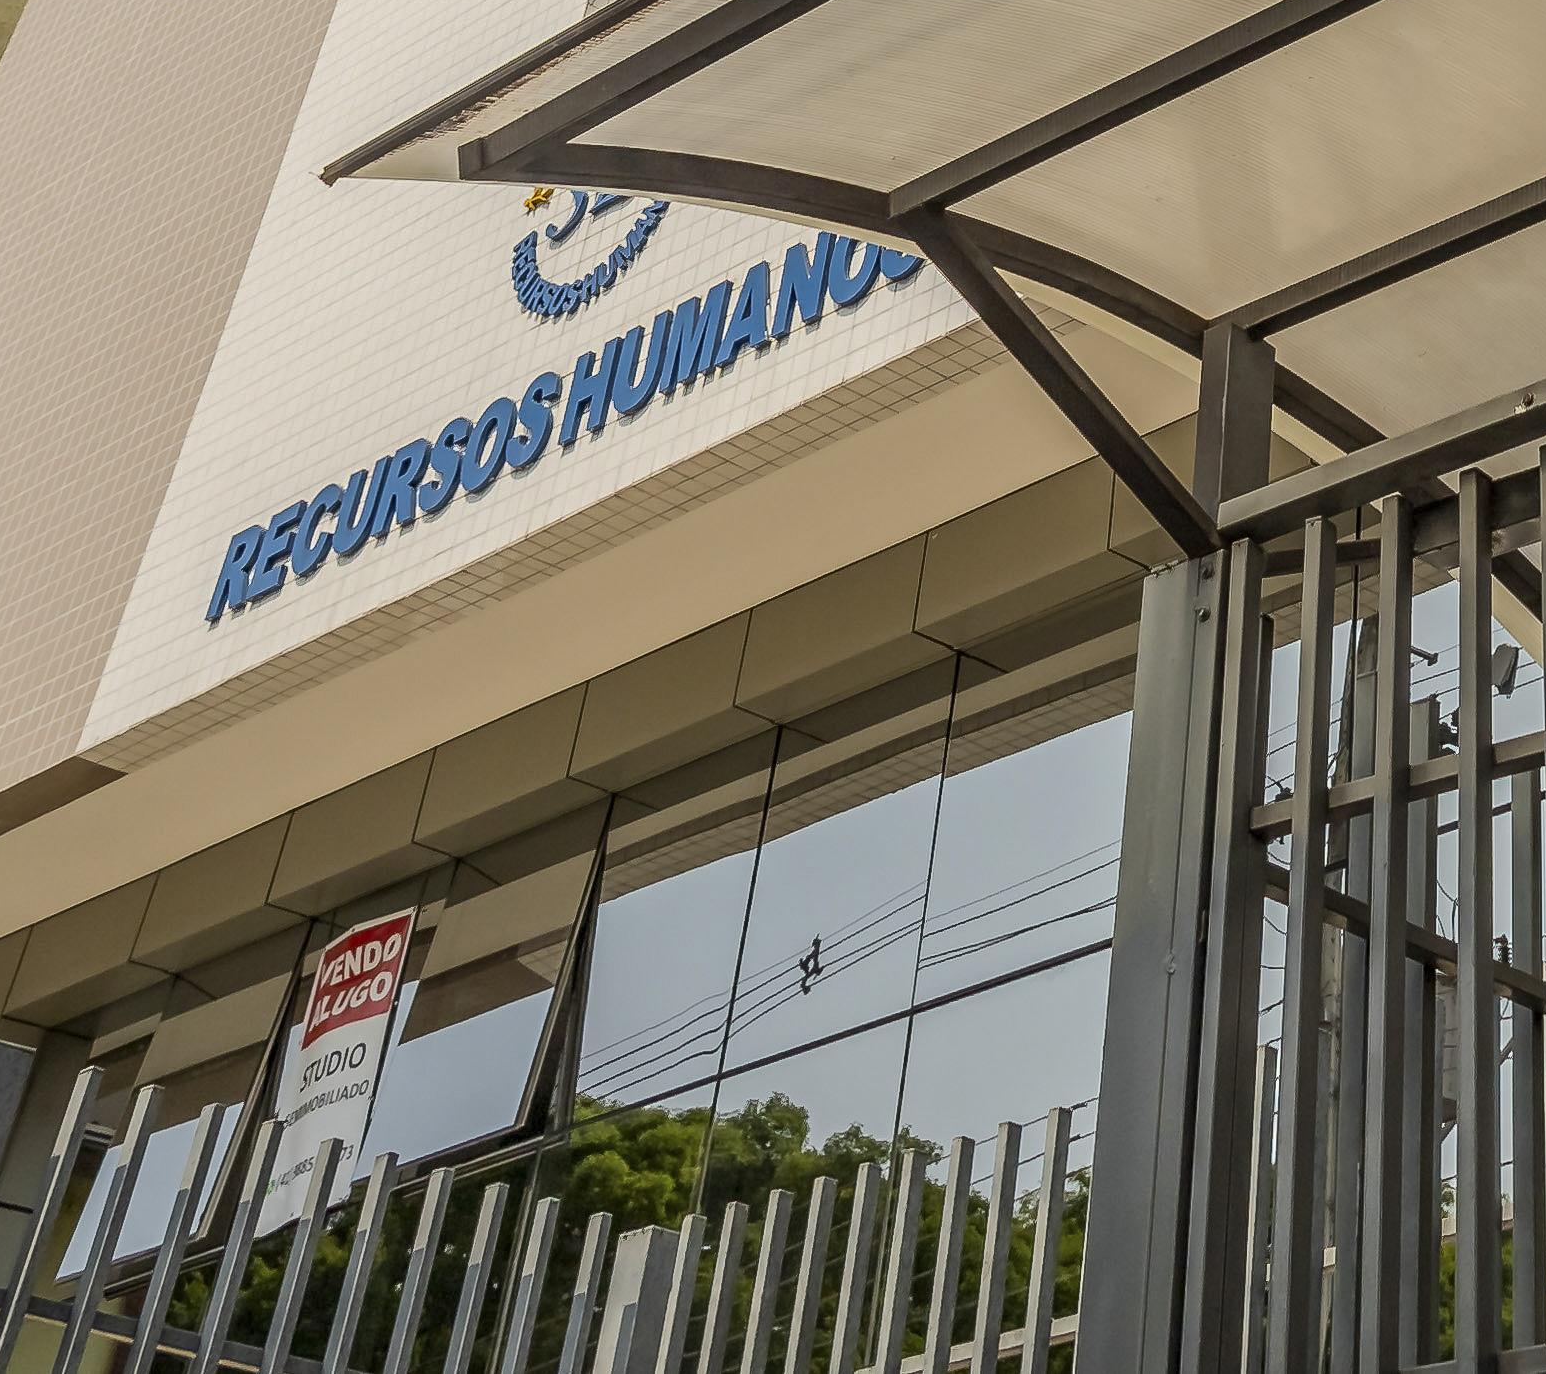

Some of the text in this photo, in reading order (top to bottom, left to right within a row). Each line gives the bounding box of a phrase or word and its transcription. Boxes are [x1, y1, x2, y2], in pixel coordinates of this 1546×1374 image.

[512, 230, 583, 318] RECURSOS
[205, 371, 563, 622] RECURSOS
[319, 932, 403, 990] VENDO
[309, 971, 394, 1032] ALUGO
[300, 1042, 367, 1093] STUDIO
